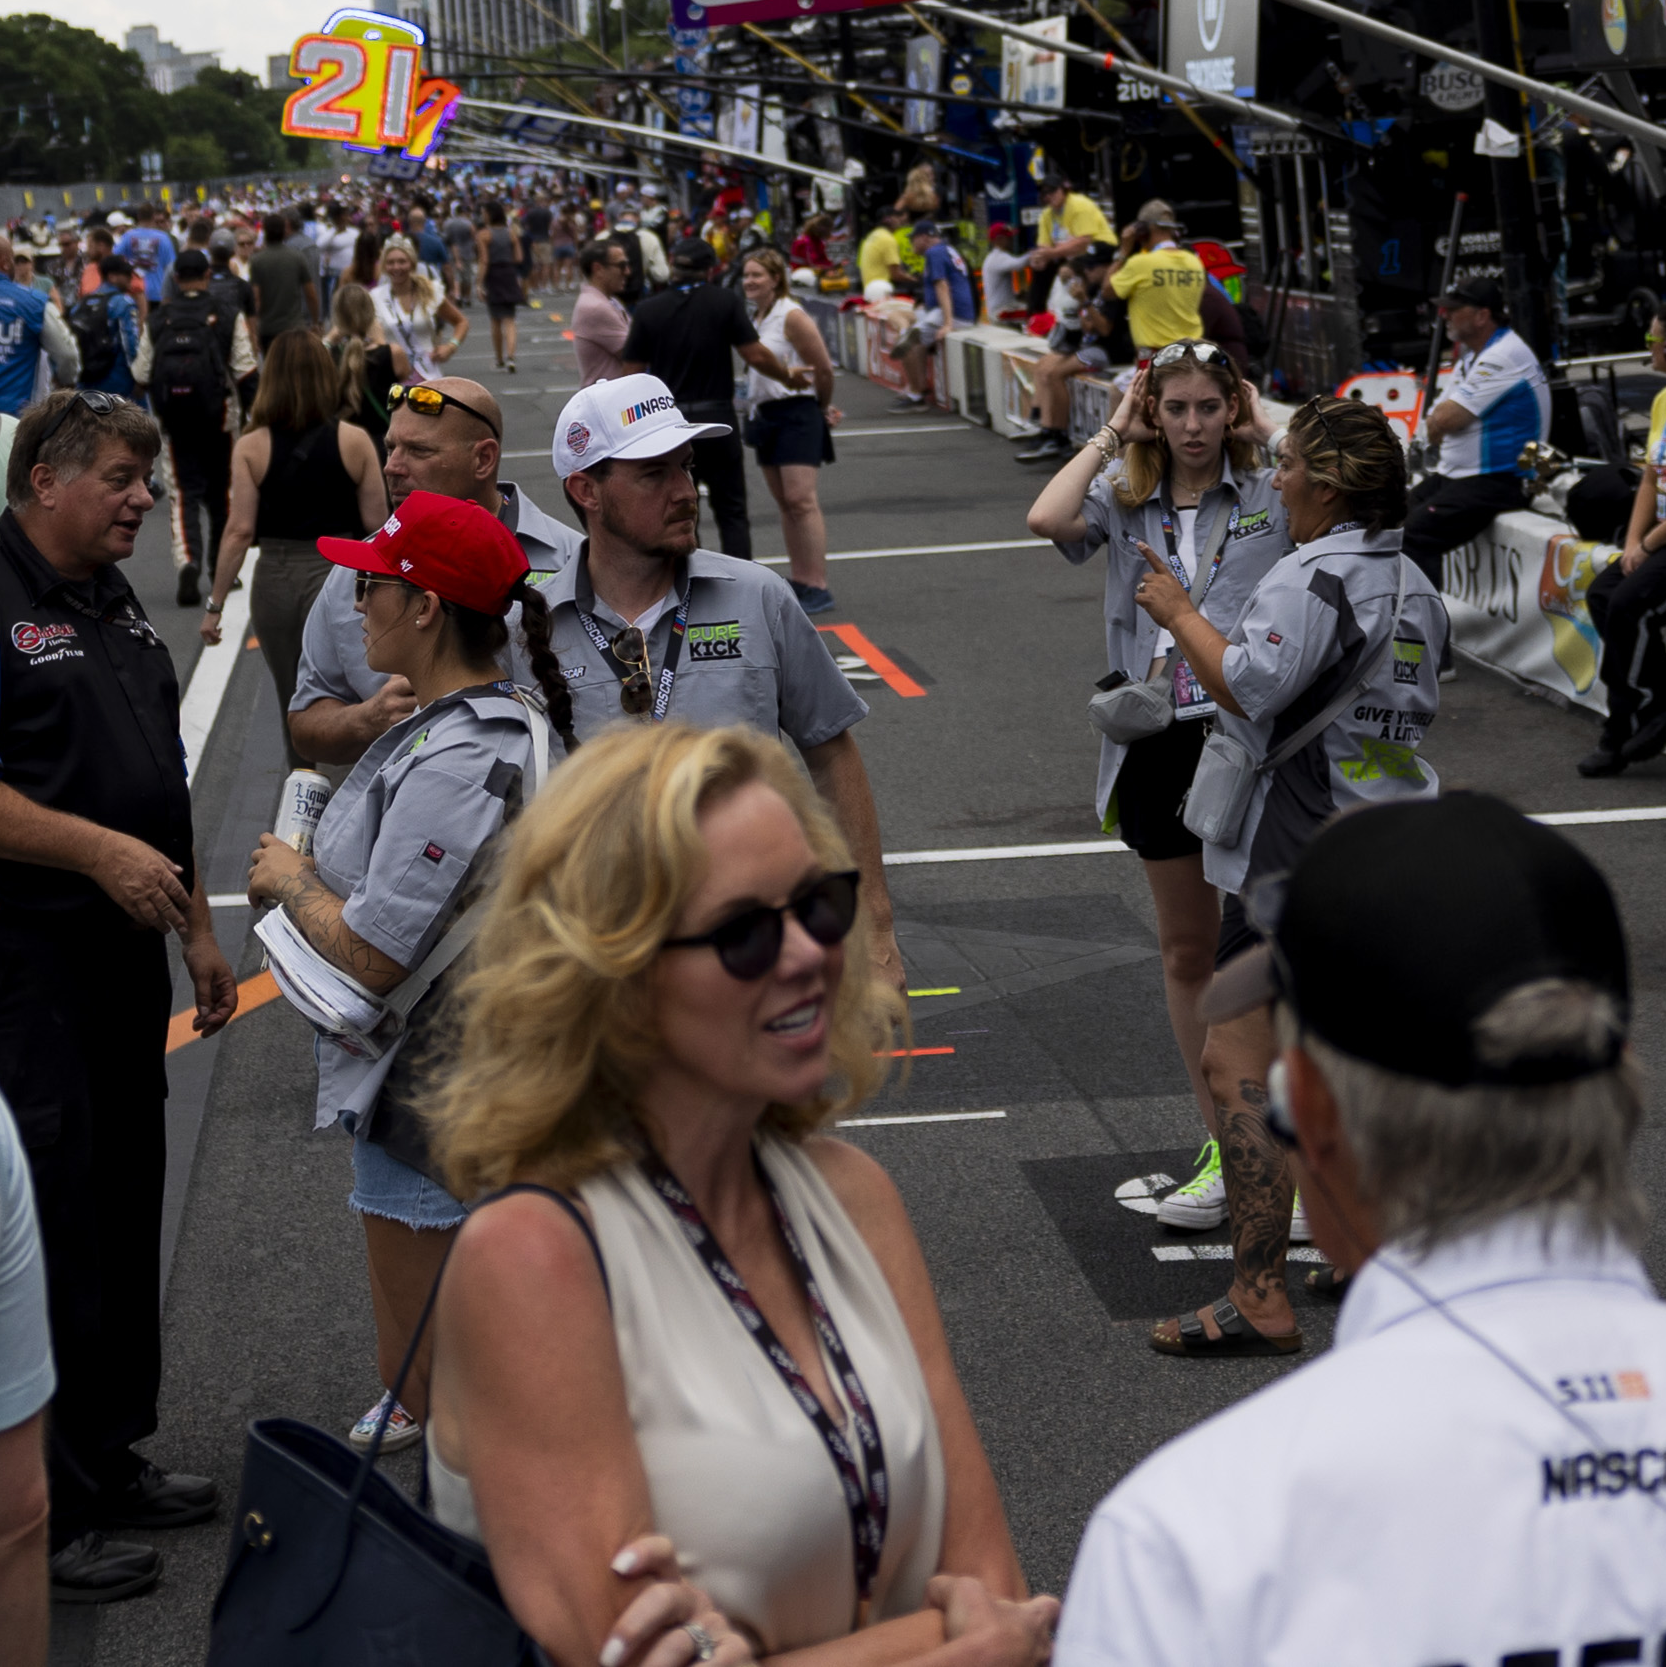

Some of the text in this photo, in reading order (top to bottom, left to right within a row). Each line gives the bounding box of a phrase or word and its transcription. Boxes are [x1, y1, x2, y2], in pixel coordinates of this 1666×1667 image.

[282, 33, 419, 145] 21
[1421, 73, 1484, 92] BUSC
[1152, 269, 1207, 287] STAFF
[642, 394, 680, 416] NASC
[675, 584, 693, 622] NASC
[579, 610, 609, 651] NASCAR
[688, 622, 741, 644] PURE
[30, 648, 85, 666] GOODYEAR
[690, 638, 742, 658] KICK
[561, 668, 584, 680] SCAR
[1393, 659, 1420, 681] KICK
[653, 668, 675, 718] NASCAR
[1353, 706, 1394, 724] GIVE
[1379, 725, 1391, 741] A
